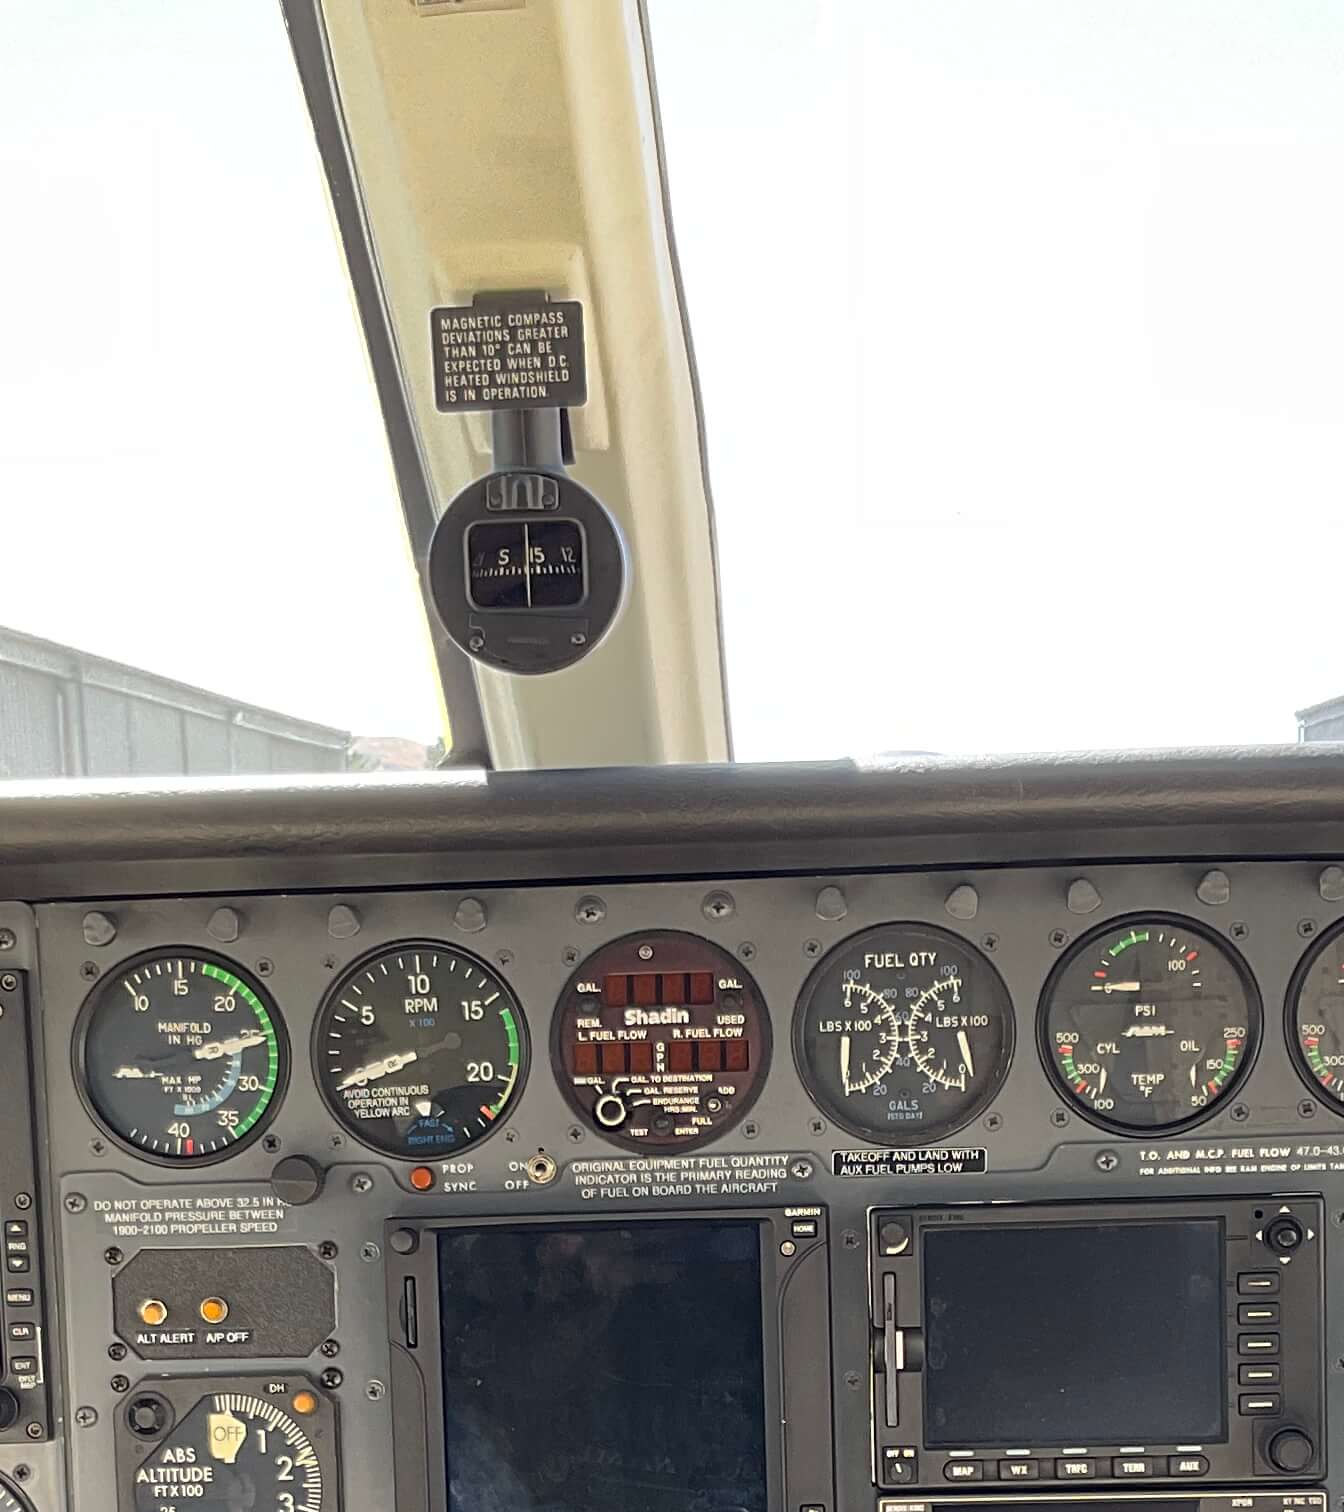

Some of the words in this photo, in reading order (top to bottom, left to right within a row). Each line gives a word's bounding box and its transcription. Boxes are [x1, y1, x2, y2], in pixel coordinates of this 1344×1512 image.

[441, 315, 502, 330] MAGNETIC
[508, 312, 564, 326] COMPASS
[442, 330, 510, 344] DEVIATIONS
[518, 327, 568, 340] GREATER
[444, 345, 475, 357] THAN
[483, 344, 500, 356] 10°
[508, 343, 531, 355] CAN
[538, 342, 552, 353] BE
[444, 359, 501, 372] EXPECTED
[507, 357, 541, 370] WHEN
[548, 356, 569, 368] D.C.
[445, 374, 490, 387] HEATED
[496, 370, 569, 385] WINDSHIELD
[445, 390, 456, 402] IS
[464, 389, 475, 401] IN
[865, 953, 903, 969] FUEL
[908, 951, 938, 968] QTY
[408, 976, 430, 994] 10
[214, 996, 235, 1011] 20
[405, 998, 438, 1014] RPM
[461, 1002, 484, 1020] 15
[624, 1007, 690, 1026] Shadin
[717, 1014, 745, 1025] USED
[158, 1022, 211, 1034] MANIFOLD
[589, 1030, 616, 1041] FUEL
[618, 1029, 647, 1040] FLOW
[686, 1028, 711, 1039] FUEL
[713, 1027, 743, 1038] FLOW
[168, 1035, 182, 1046] IN
[187, 1035, 203, 1046] HG
[1097, 1042, 1120, 1055] CYL
[467, 1063, 493, 1082] 20
[1131, 1073, 1164, 1086] TEMP
[239, 1076, 259, 1091] 30
[343, 1089, 370, 1100] AVOID
[371, 1085, 429, 1097] CONTINUOUS
[348, 1098, 397, 1109] OPERATION
[399, 1097, 409, 1107] IN
[354, 1107, 388, 1119] YELLOW
[389, 1106, 410, 1117] ARC
[168, 1123, 190, 1138] 40
[840, 1152, 890, 1164] TAKEOFF
[892, 1151, 917, 1162] AND
[920, 1150, 949, 1161] LAND
[951, 1150, 979, 1160] WITH
[1140, 1151, 1160, 1160] T.O.
[1167, 1150, 1190, 1159] AND
[1232, 1149, 1254, 1158] FUEL
[1260, 1148, 1290, 1157] FLOW
[442, 1163, 474, 1174] PROP
[573, 1162, 627, 1173] ORIGINAL
[629, 1159, 695, 1172] EQUIPMENT
[699, 1158, 728, 1169] FUEL
[730, 1155, 789, 1169] QUANTITY
[840, 1164, 863, 1175] AUX
[865, 1164, 894, 1175] FUEL
[896, 1163, 936, 1174] PUMPS
[938, 1162, 963, 1173] LOW
[575, 1174, 638, 1185] INDICATOR
[641, 1172, 652, 1183] IS
[655, 1172, 677, 1183] THE
[680, 1171, 732, 1182] PRIMARY
[735, 1169, 787, 1180] READING
[444, 1181, 477, 1192] SYNC
[582, 1189, 597, 1199] OF
[601, 1187, 629, 1199] FUEL
[632, 1186, 649, 1197] ON
[652, 1185, 692, 1197] BOARD
[695, 1184, 718, 1195] THE
[721, 1182, 778, 1195] AIRCRAFT
[94, 1201, 111, 1210] DO
[114, 1201, 136, 1210] NOT
[141, 1200, 192, 1209] OPERATE
[197, 1199, 232, 1208] ABOVE
[237, 1199, 259, 1207] 32.5
[263, 1198, 275, 1207] IN
[105, 1213, 162, 1223] MANIFOLD
[165, 1212, 225, 1221] PRESSURE
[230, 1210, 284, 1220] BETWEEN
[114, 1225, 168, 1235] 1900-2100
[171, 1223, 237, 1234] PROPELLER
[240, 1223, 277, 1233] SPEED
[137, 1333, 159, 1343] ALT
[160, 1332, 195, 1343] ALERT
[206, 1333, 225, 1343] A/P
[226, 1332, 249, 1342] OFF
[269, 1383, 285, 1393] DH
[213, 1426, 244, 1442] OFF
[163, 1448, 196, 1463] ABS
[137, 1467, 213, 1483] ALTITUDE
[154, 1485, 168, 1497] FT
[169, 1485, 178, 1497] X
[179, 1485, 203, 1497] 100
